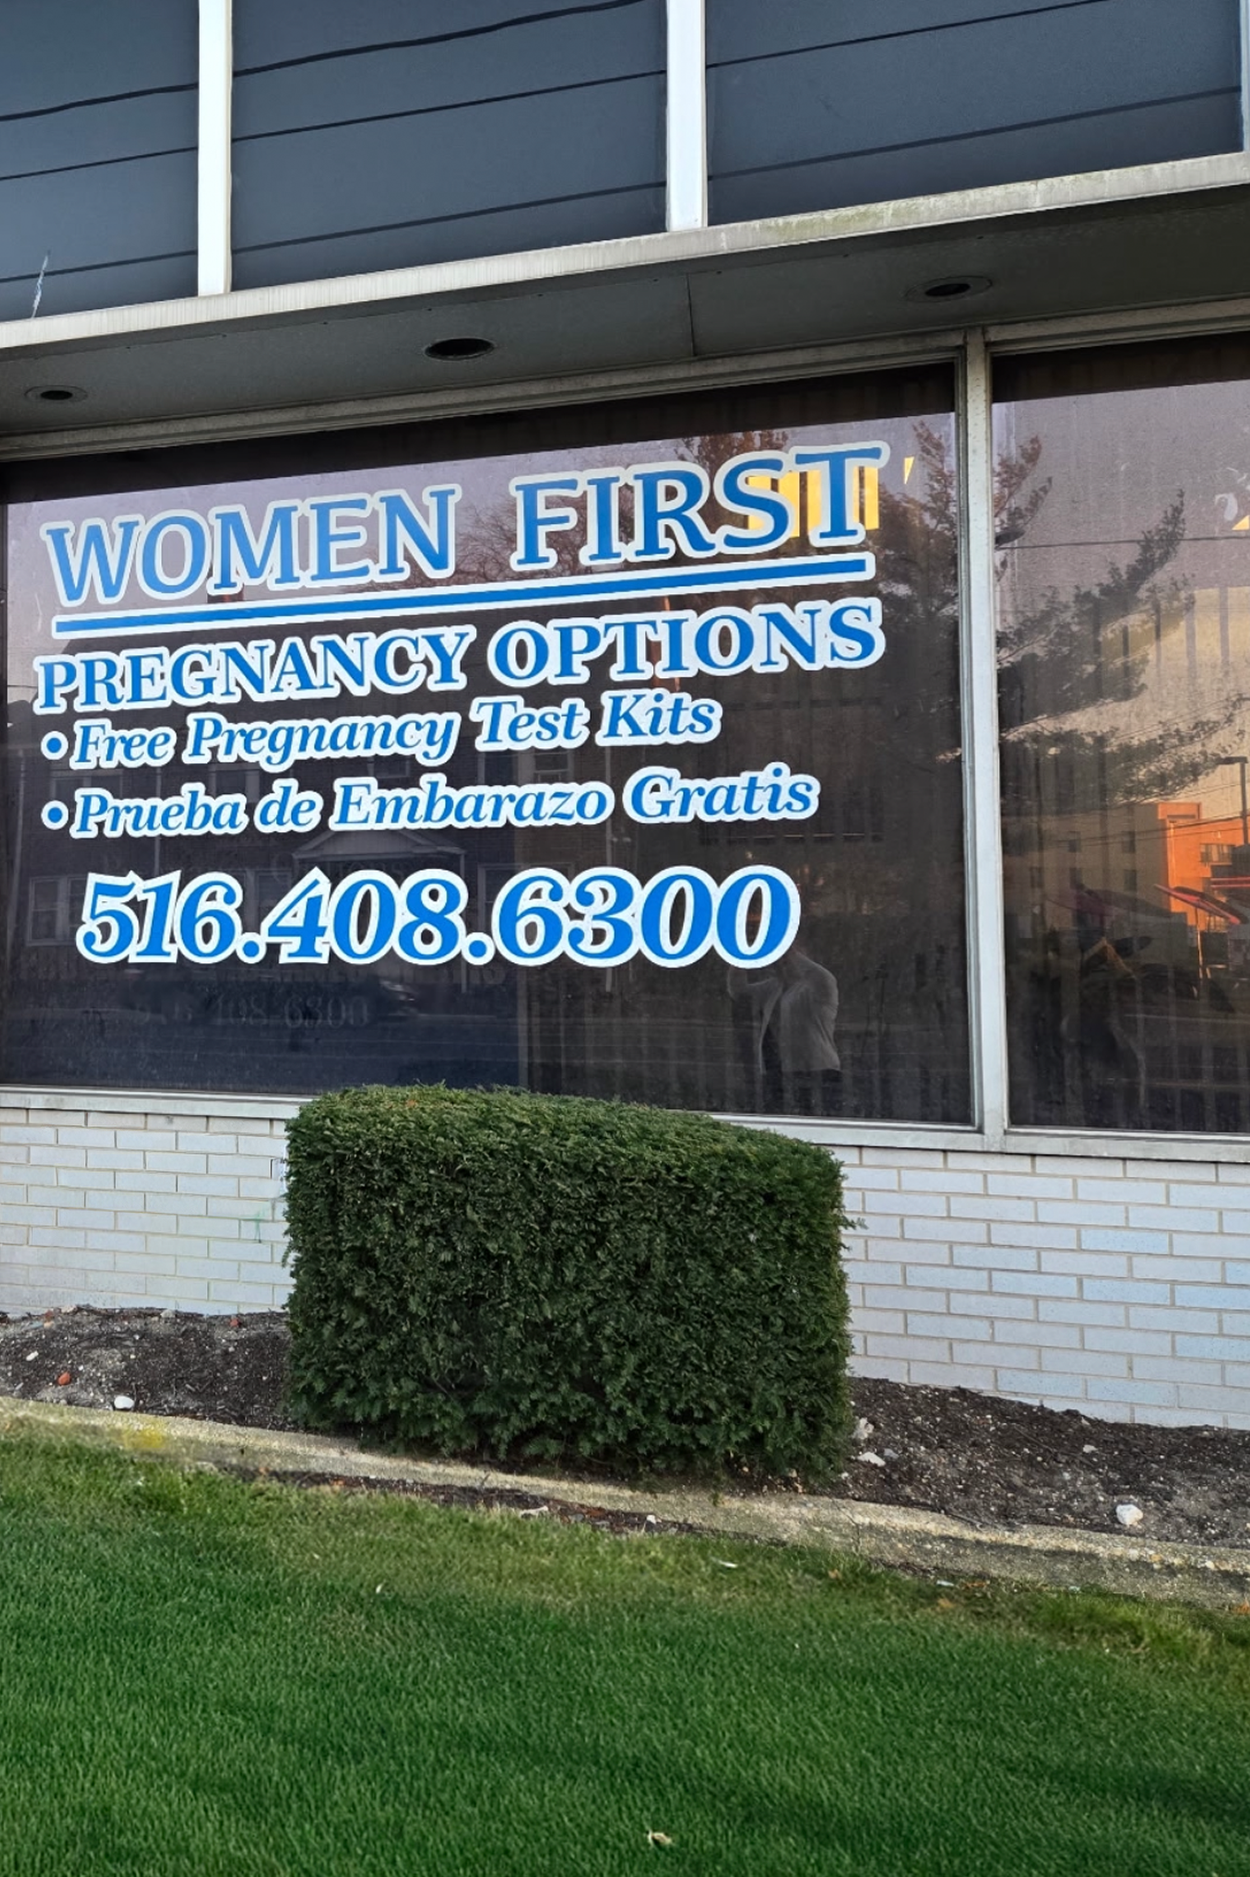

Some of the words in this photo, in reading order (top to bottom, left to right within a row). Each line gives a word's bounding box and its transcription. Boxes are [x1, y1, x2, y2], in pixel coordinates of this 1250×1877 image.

[42, 483, 461, 606] WOMEN
[511, 440, 890, 571] FIRST
[35, 625, 476, 714] PREGNANCY
[487, 597, 885, 687] OPTIONS
[70, 719, 176, 770] Free
[183, 712, 461, 772] Pregnancy
[470, 695, 589, 751] Test
[595, 689, 723, 746] Kits
[70, 782, 249, 838] Prueba
[255, 778, 323, 832] de
[328, 773, 615, 831] Embarazo
[622, 762, 820, 824] Gratis
[76, 866, 800, 968] 516.408.6300
